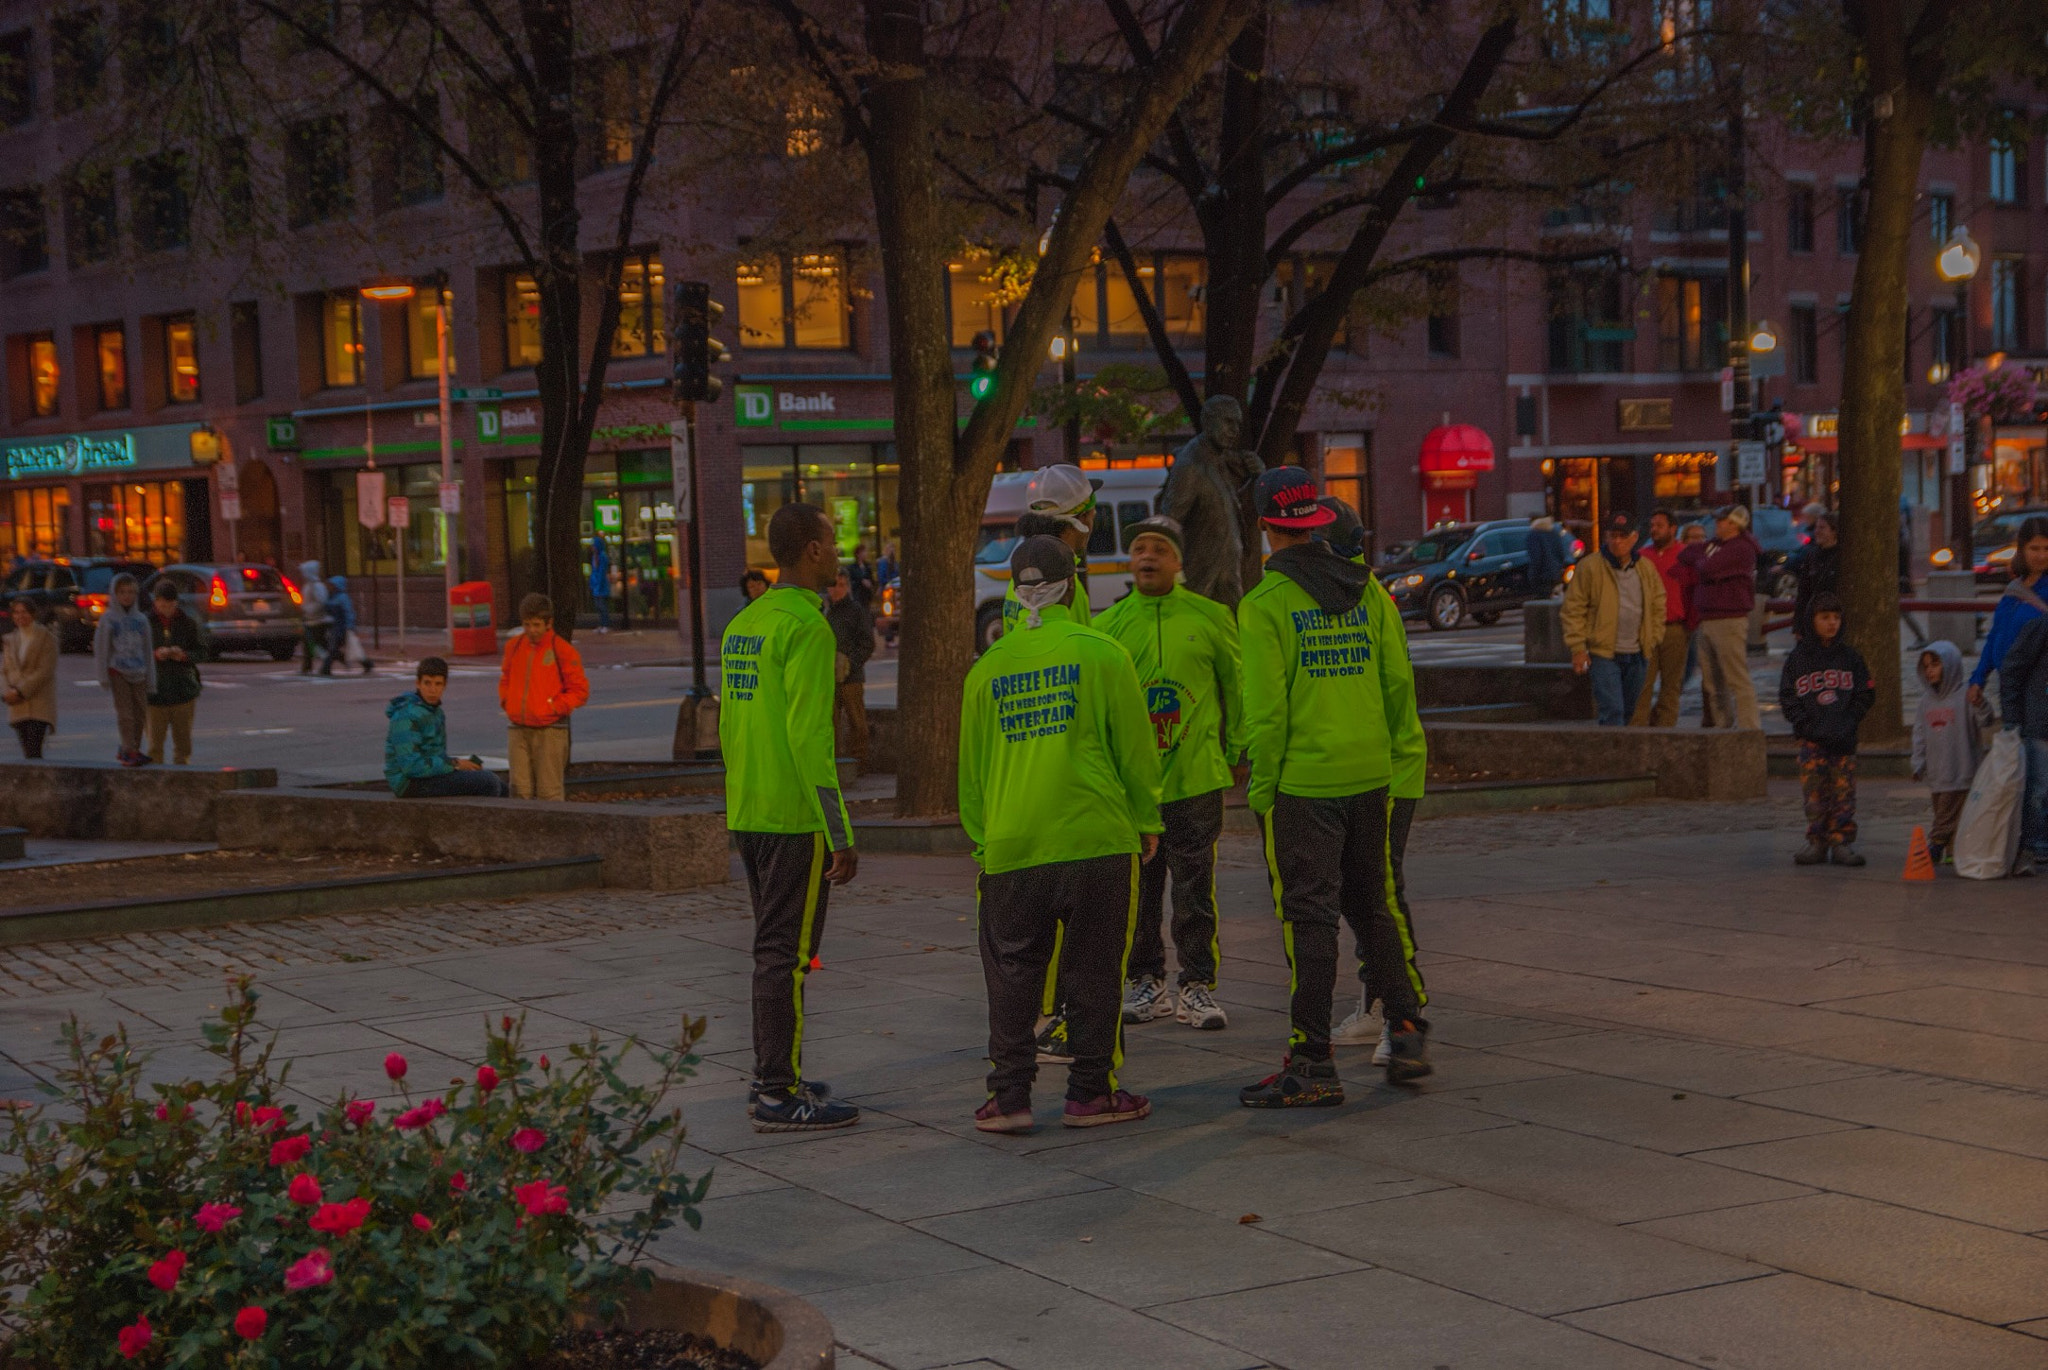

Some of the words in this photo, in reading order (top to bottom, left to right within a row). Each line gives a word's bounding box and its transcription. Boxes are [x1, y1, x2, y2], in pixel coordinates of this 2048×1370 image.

[739, 392, 770, 419] TD
[780, 392, 835, 411] Bank
[480, 410, 498, 436] TD
[502, 407, 536, 427] Bank
[597, 505, 620, 526] TD
[1291, 608, 1334, 634] BREEZE
[1301, 646, 1371, 667] ENTERTAIN
[992, 670, 1040, 700] BREEZE
[1043, 663, 1080, 689] TEAM
[1308, 668, 1327, 678] THE
[1328, 665, 1364, 677] WORLD
[1796, 668, 1854, 697] SCSU
[1016, 696, 1036, 710] WERE
[1037, 692, 1057, 706] BORN
[1000, 704, 1075, 733] ENTERTAIN
[1006, 731, 1027, 744] THE
[1029, 723, 1067, 739] WORLD
